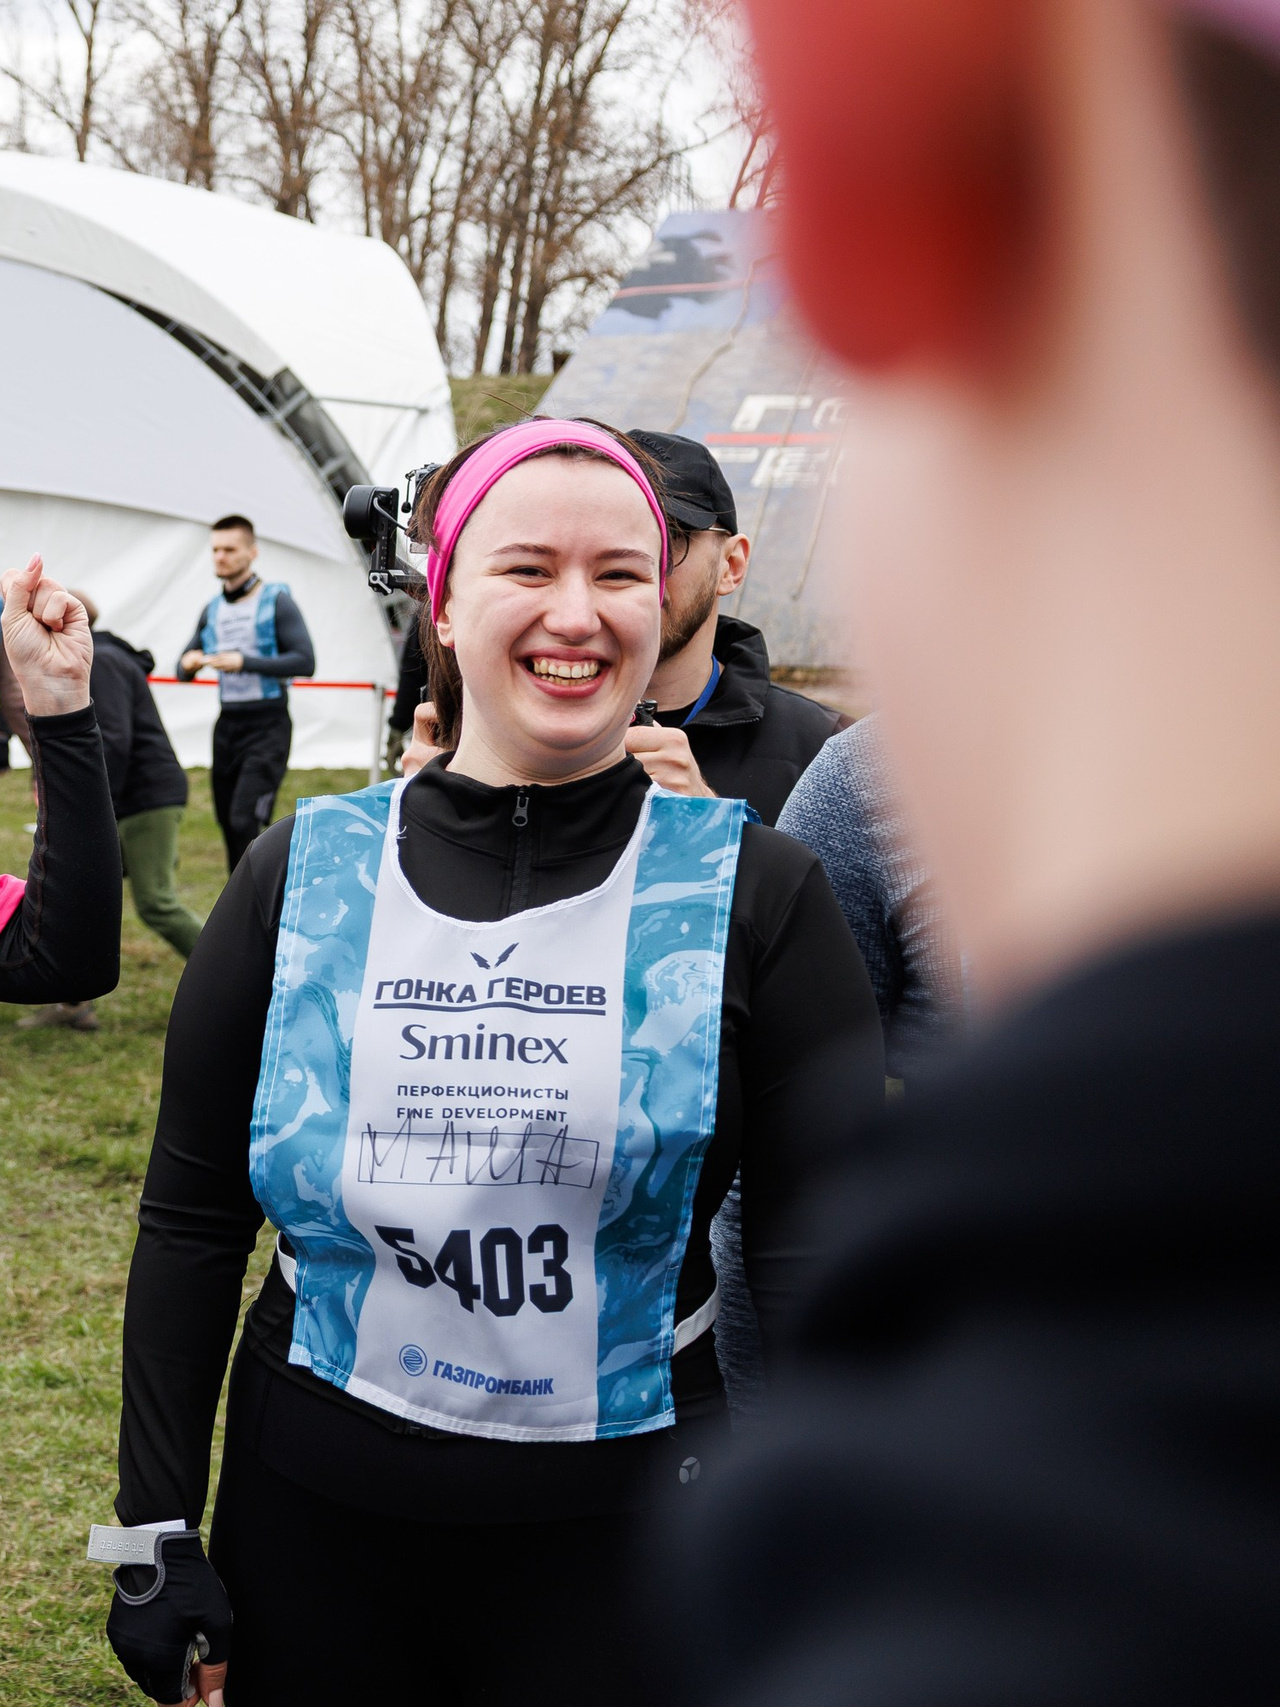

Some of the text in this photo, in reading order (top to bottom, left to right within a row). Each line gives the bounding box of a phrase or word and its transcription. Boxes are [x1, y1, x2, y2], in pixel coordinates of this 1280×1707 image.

[375, 976, 607, 1006] ГОНКА ГЕРОЕВ
[399, 1023, 569, 1064] Sminex
[397, 1085, 569, 1100] ПЕРФЕКЦИОНИСТЫ
[397, 1107, 567, 1122] FINE DEVELOPMENT
[374, 1224, 574, 1317] 5403
[433, 1360, 554, 1395] ГАЗПРОМБАНК
